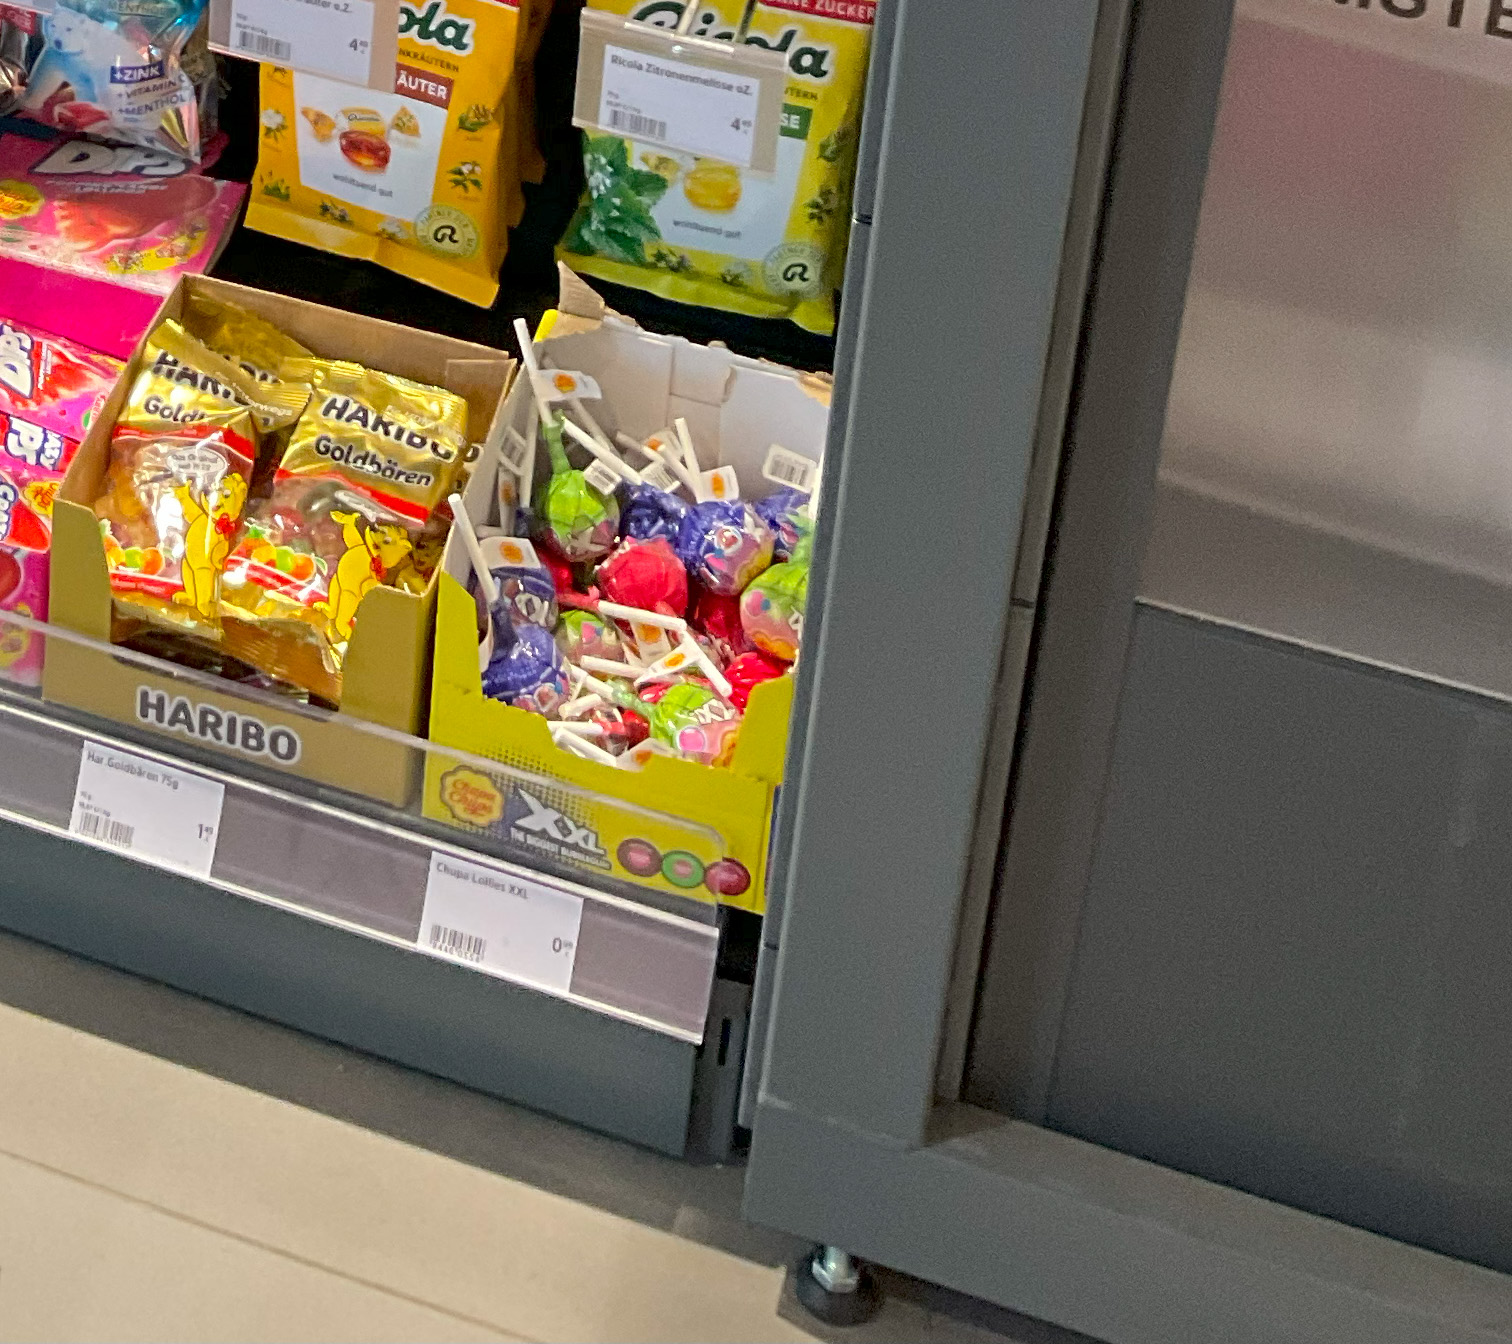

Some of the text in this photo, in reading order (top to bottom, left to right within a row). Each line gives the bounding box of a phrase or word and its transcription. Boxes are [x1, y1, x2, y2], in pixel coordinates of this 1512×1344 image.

[611, 53, 733, 91] Ricola Zitronenmelisse
[331, 172, 377, 195] wohltuend
[314, 434, 433, 489] Goldbären
[138, 686, 299, 763] HARIBO
[160, 774, 180, 790] 75g
[515, 790, 606, 854] XXL
[436, 861, 529, 900] Chupa Lollies XXL
